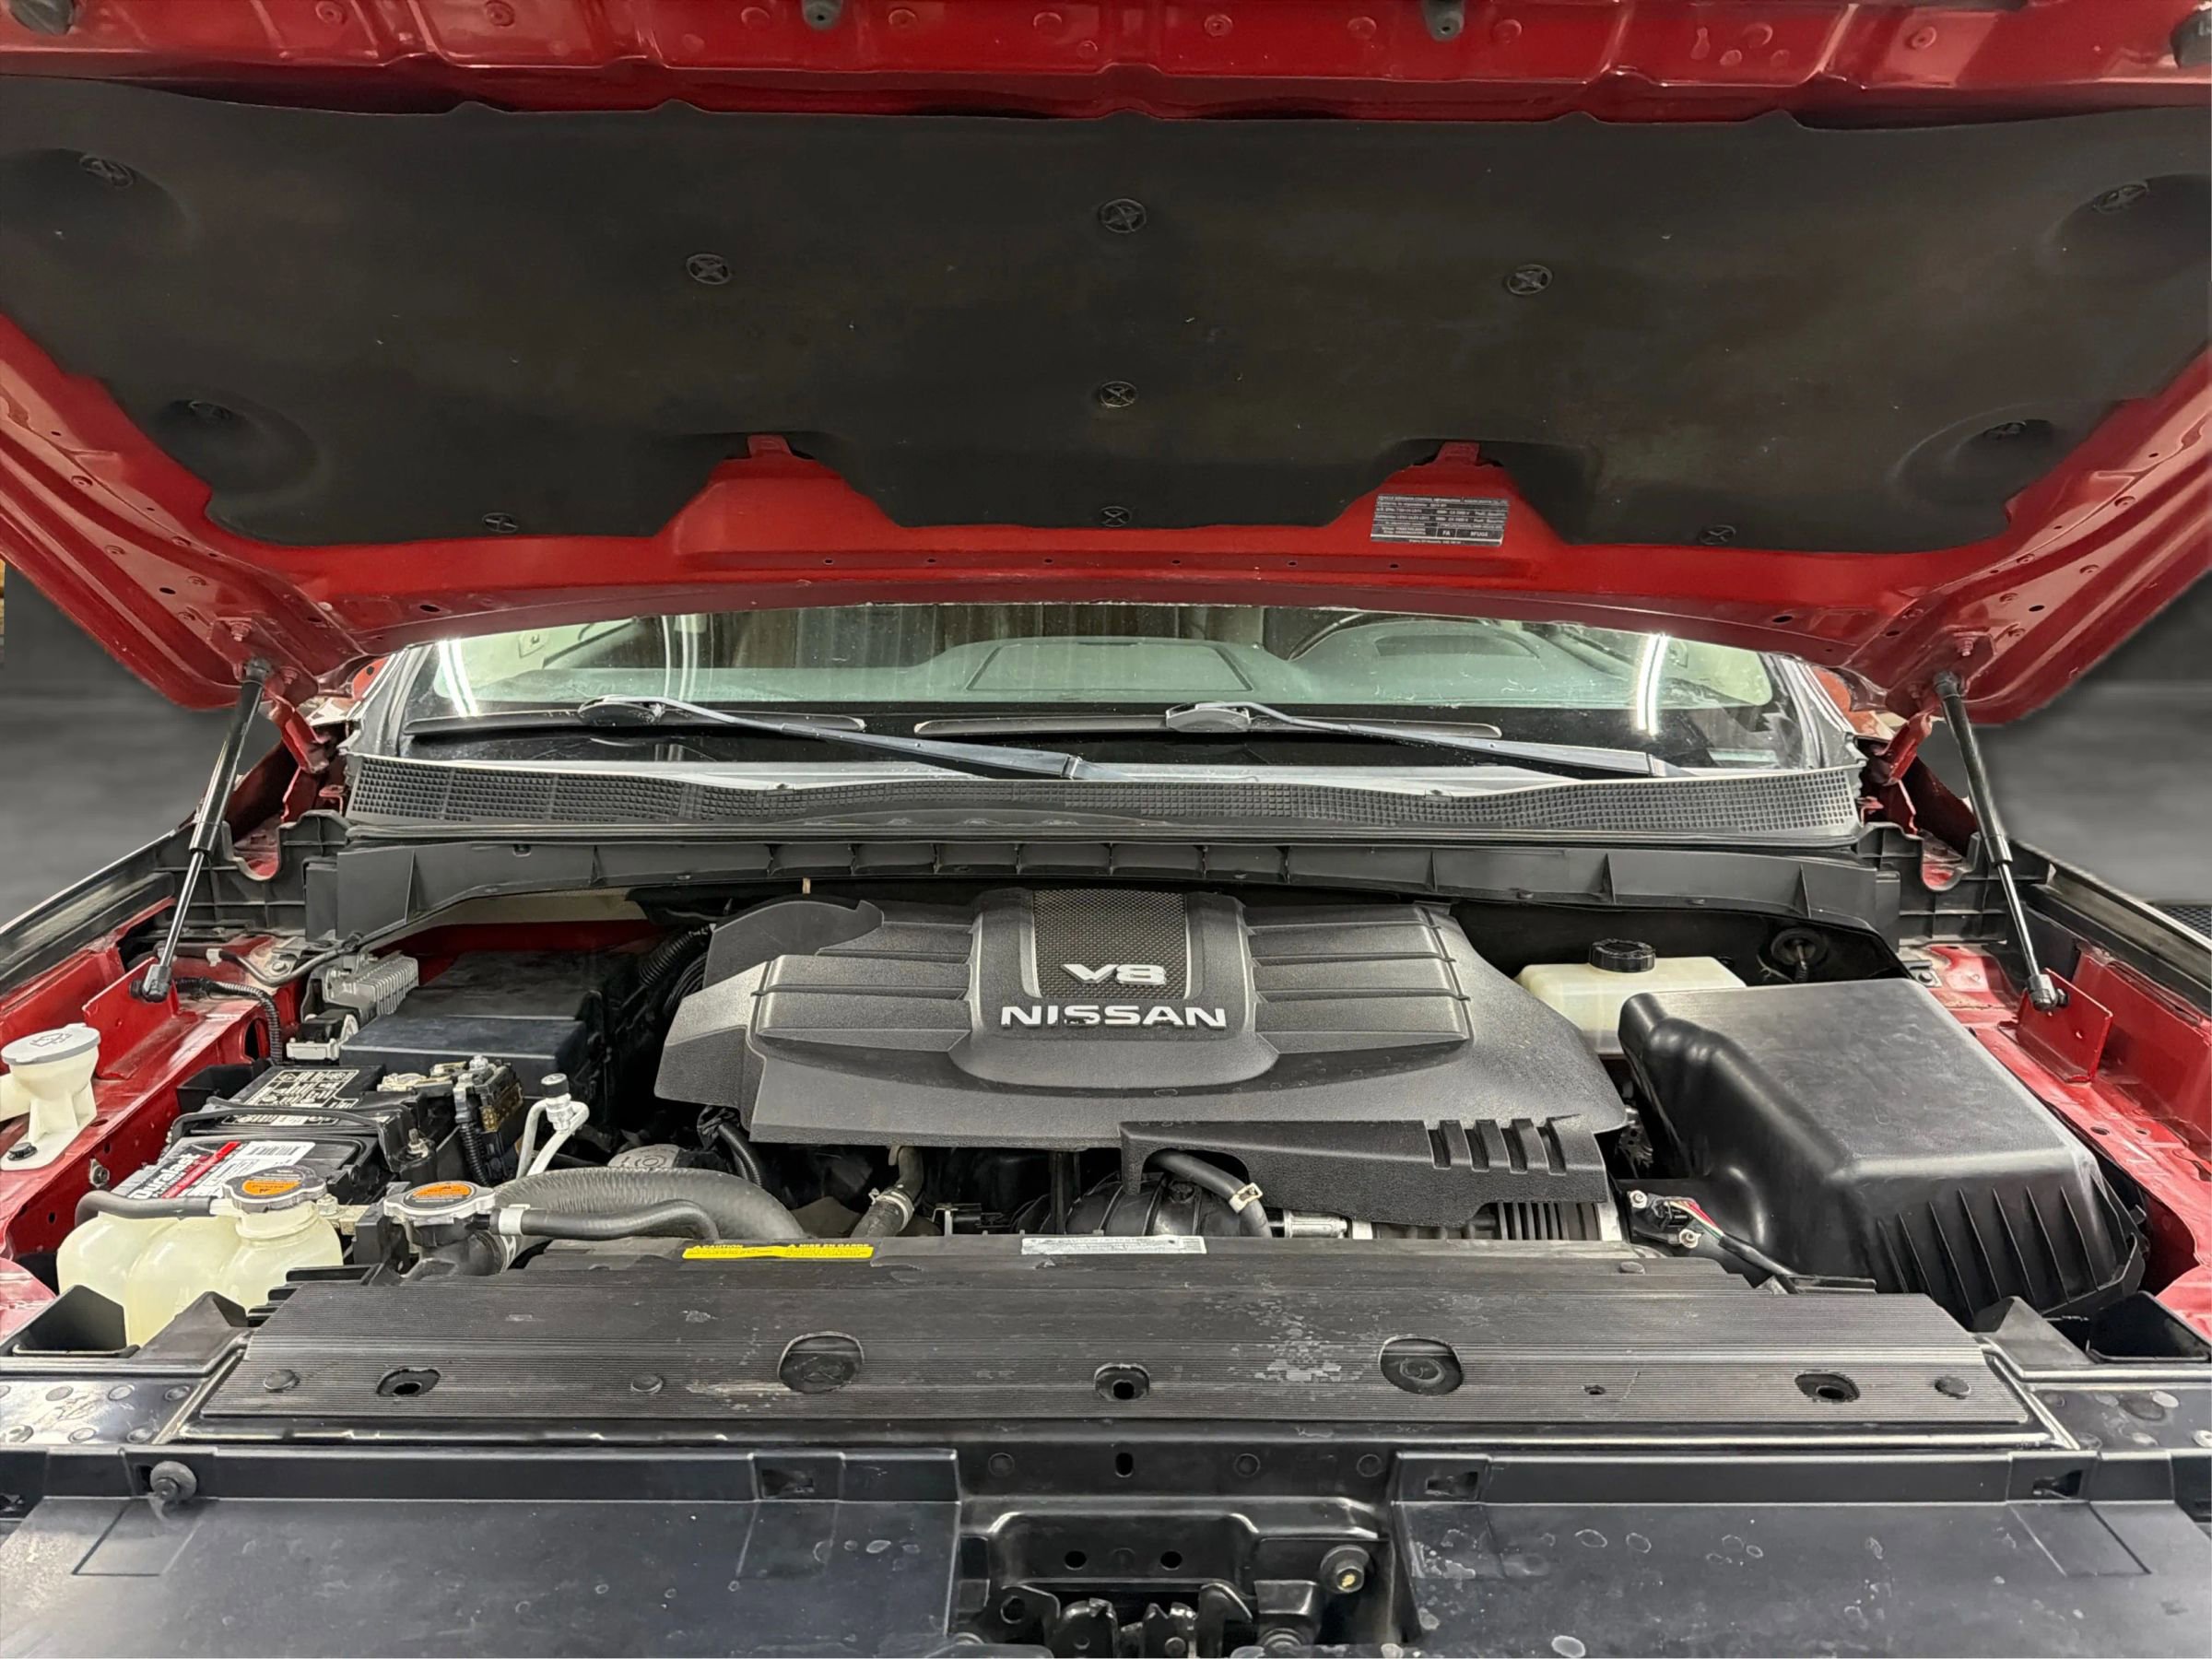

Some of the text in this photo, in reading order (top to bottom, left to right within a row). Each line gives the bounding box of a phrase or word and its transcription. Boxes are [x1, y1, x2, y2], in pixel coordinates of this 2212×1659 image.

[1062, 963, 1168, 985] V8
[1001, 1005, 1227, 1030] NISSAN
[127, 1153, 203, 1199] Duralast
